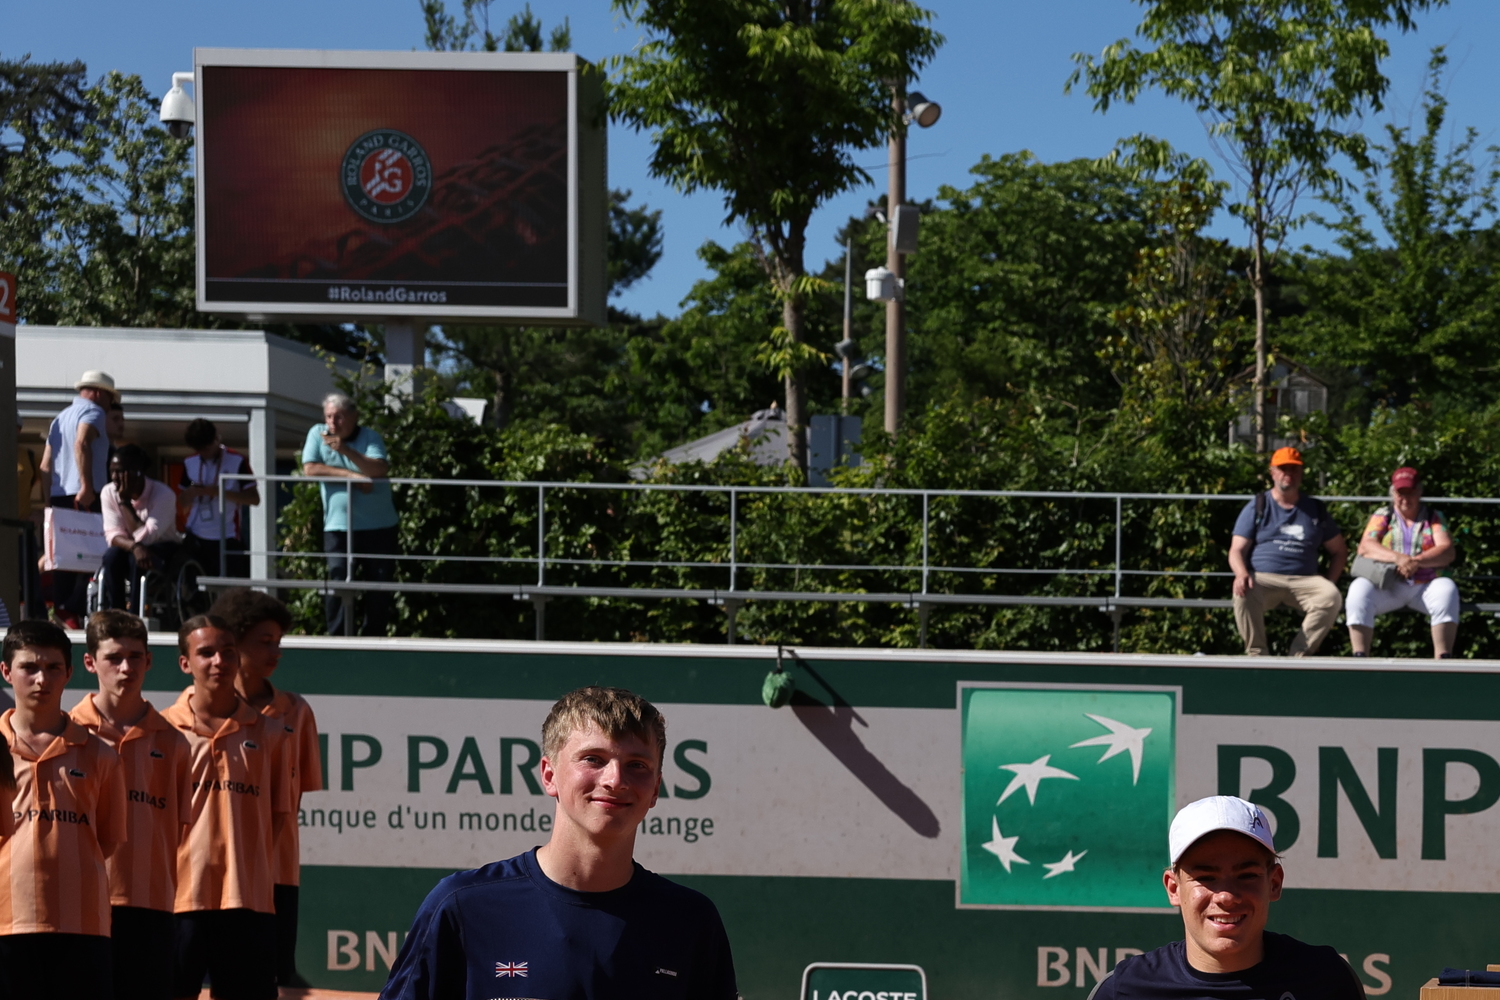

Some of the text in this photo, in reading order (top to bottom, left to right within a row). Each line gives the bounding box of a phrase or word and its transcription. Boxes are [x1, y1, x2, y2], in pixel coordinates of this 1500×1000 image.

[328, 286, 447, 303] #RolandGarros
[407, 735, 712, 800] PARS
[28, 808, 90, 826] PARIBA
[298, 804, 714, 843] anque d'un monde ange
[327, 929, 409, 972] BN
